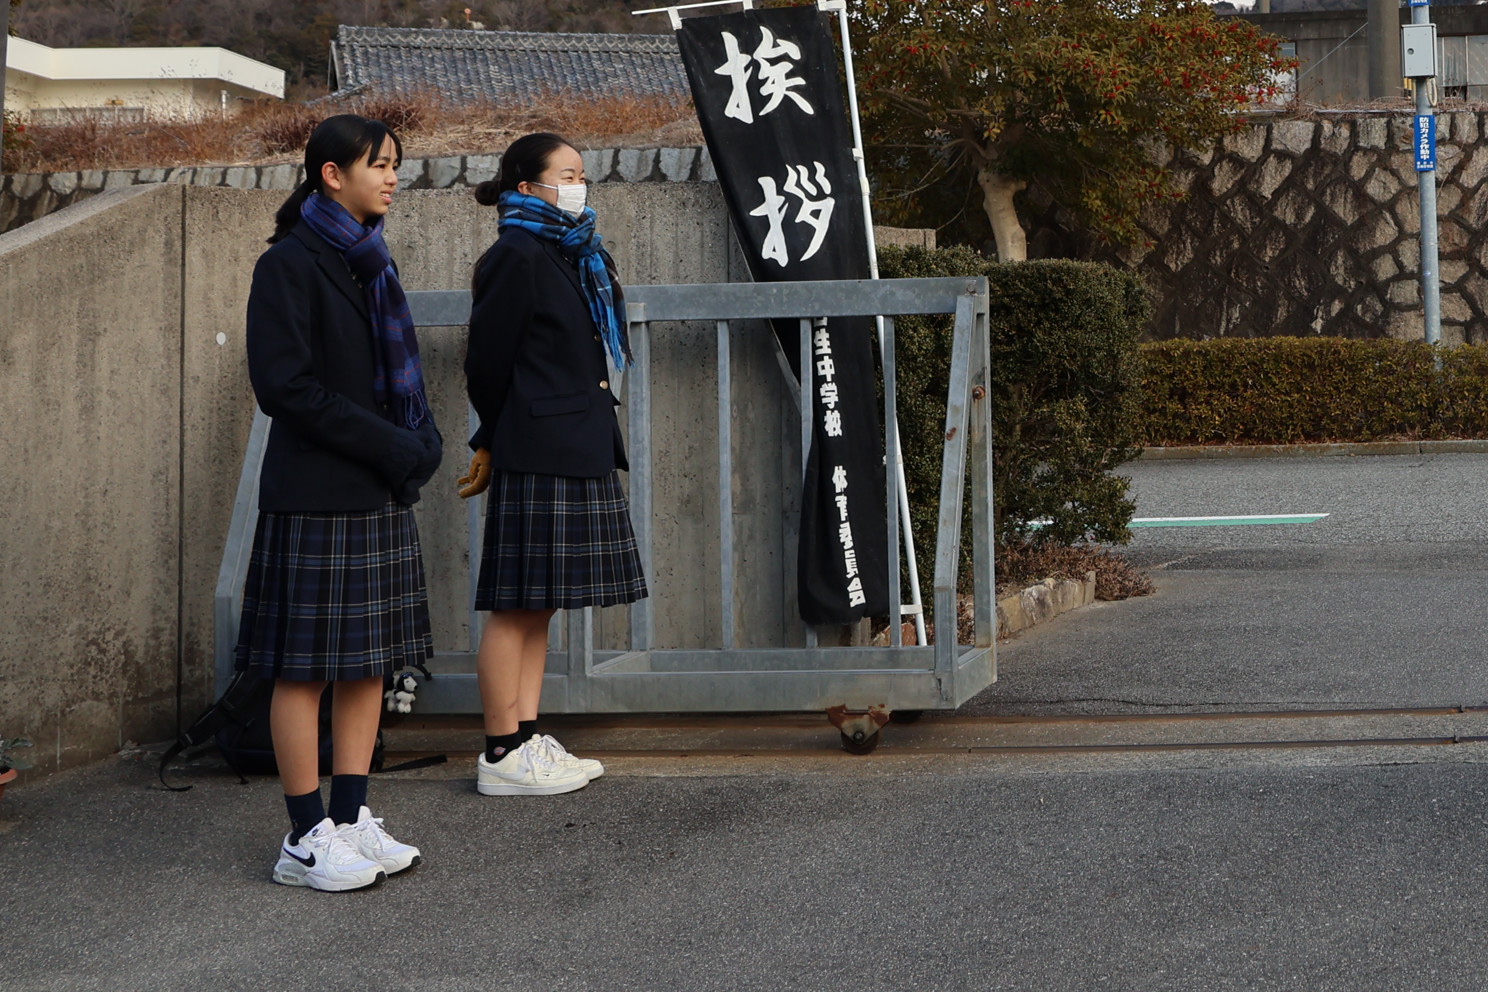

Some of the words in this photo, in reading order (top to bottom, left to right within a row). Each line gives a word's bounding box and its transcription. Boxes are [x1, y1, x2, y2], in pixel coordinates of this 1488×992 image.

[714, 26, 836, 268] 挨拶
[1419, 117, 1430, 160] 防犯カメラ作動中
